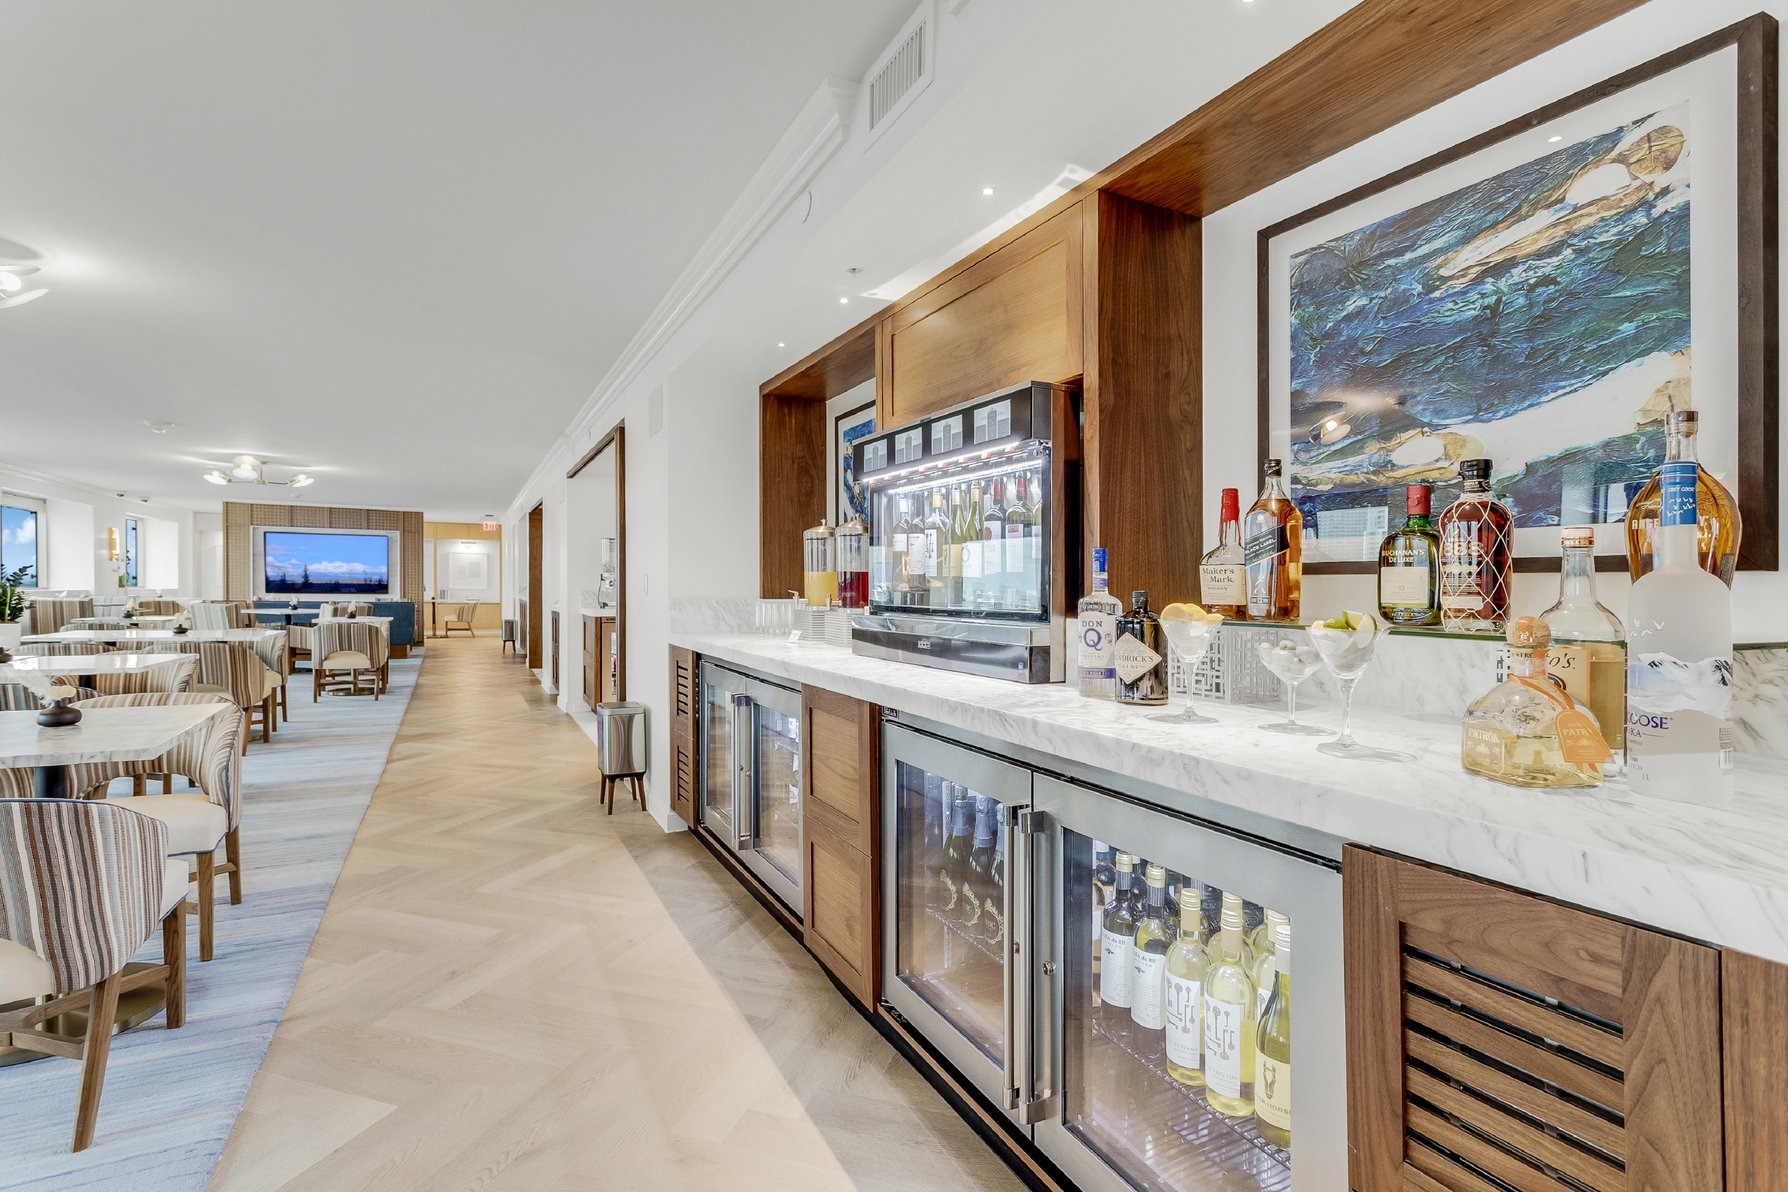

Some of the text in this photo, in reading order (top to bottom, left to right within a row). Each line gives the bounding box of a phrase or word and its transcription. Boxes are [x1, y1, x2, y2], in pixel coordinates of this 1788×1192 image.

[1381, 549, 1426, 557] BUCHANAN'S
[1201, 567, 1235, 575] Maker's
[1209, 575, 1235, 583] Mark
[1081, 620, 1103, 628] DON
[1083, 628, 1103, 651] Q
